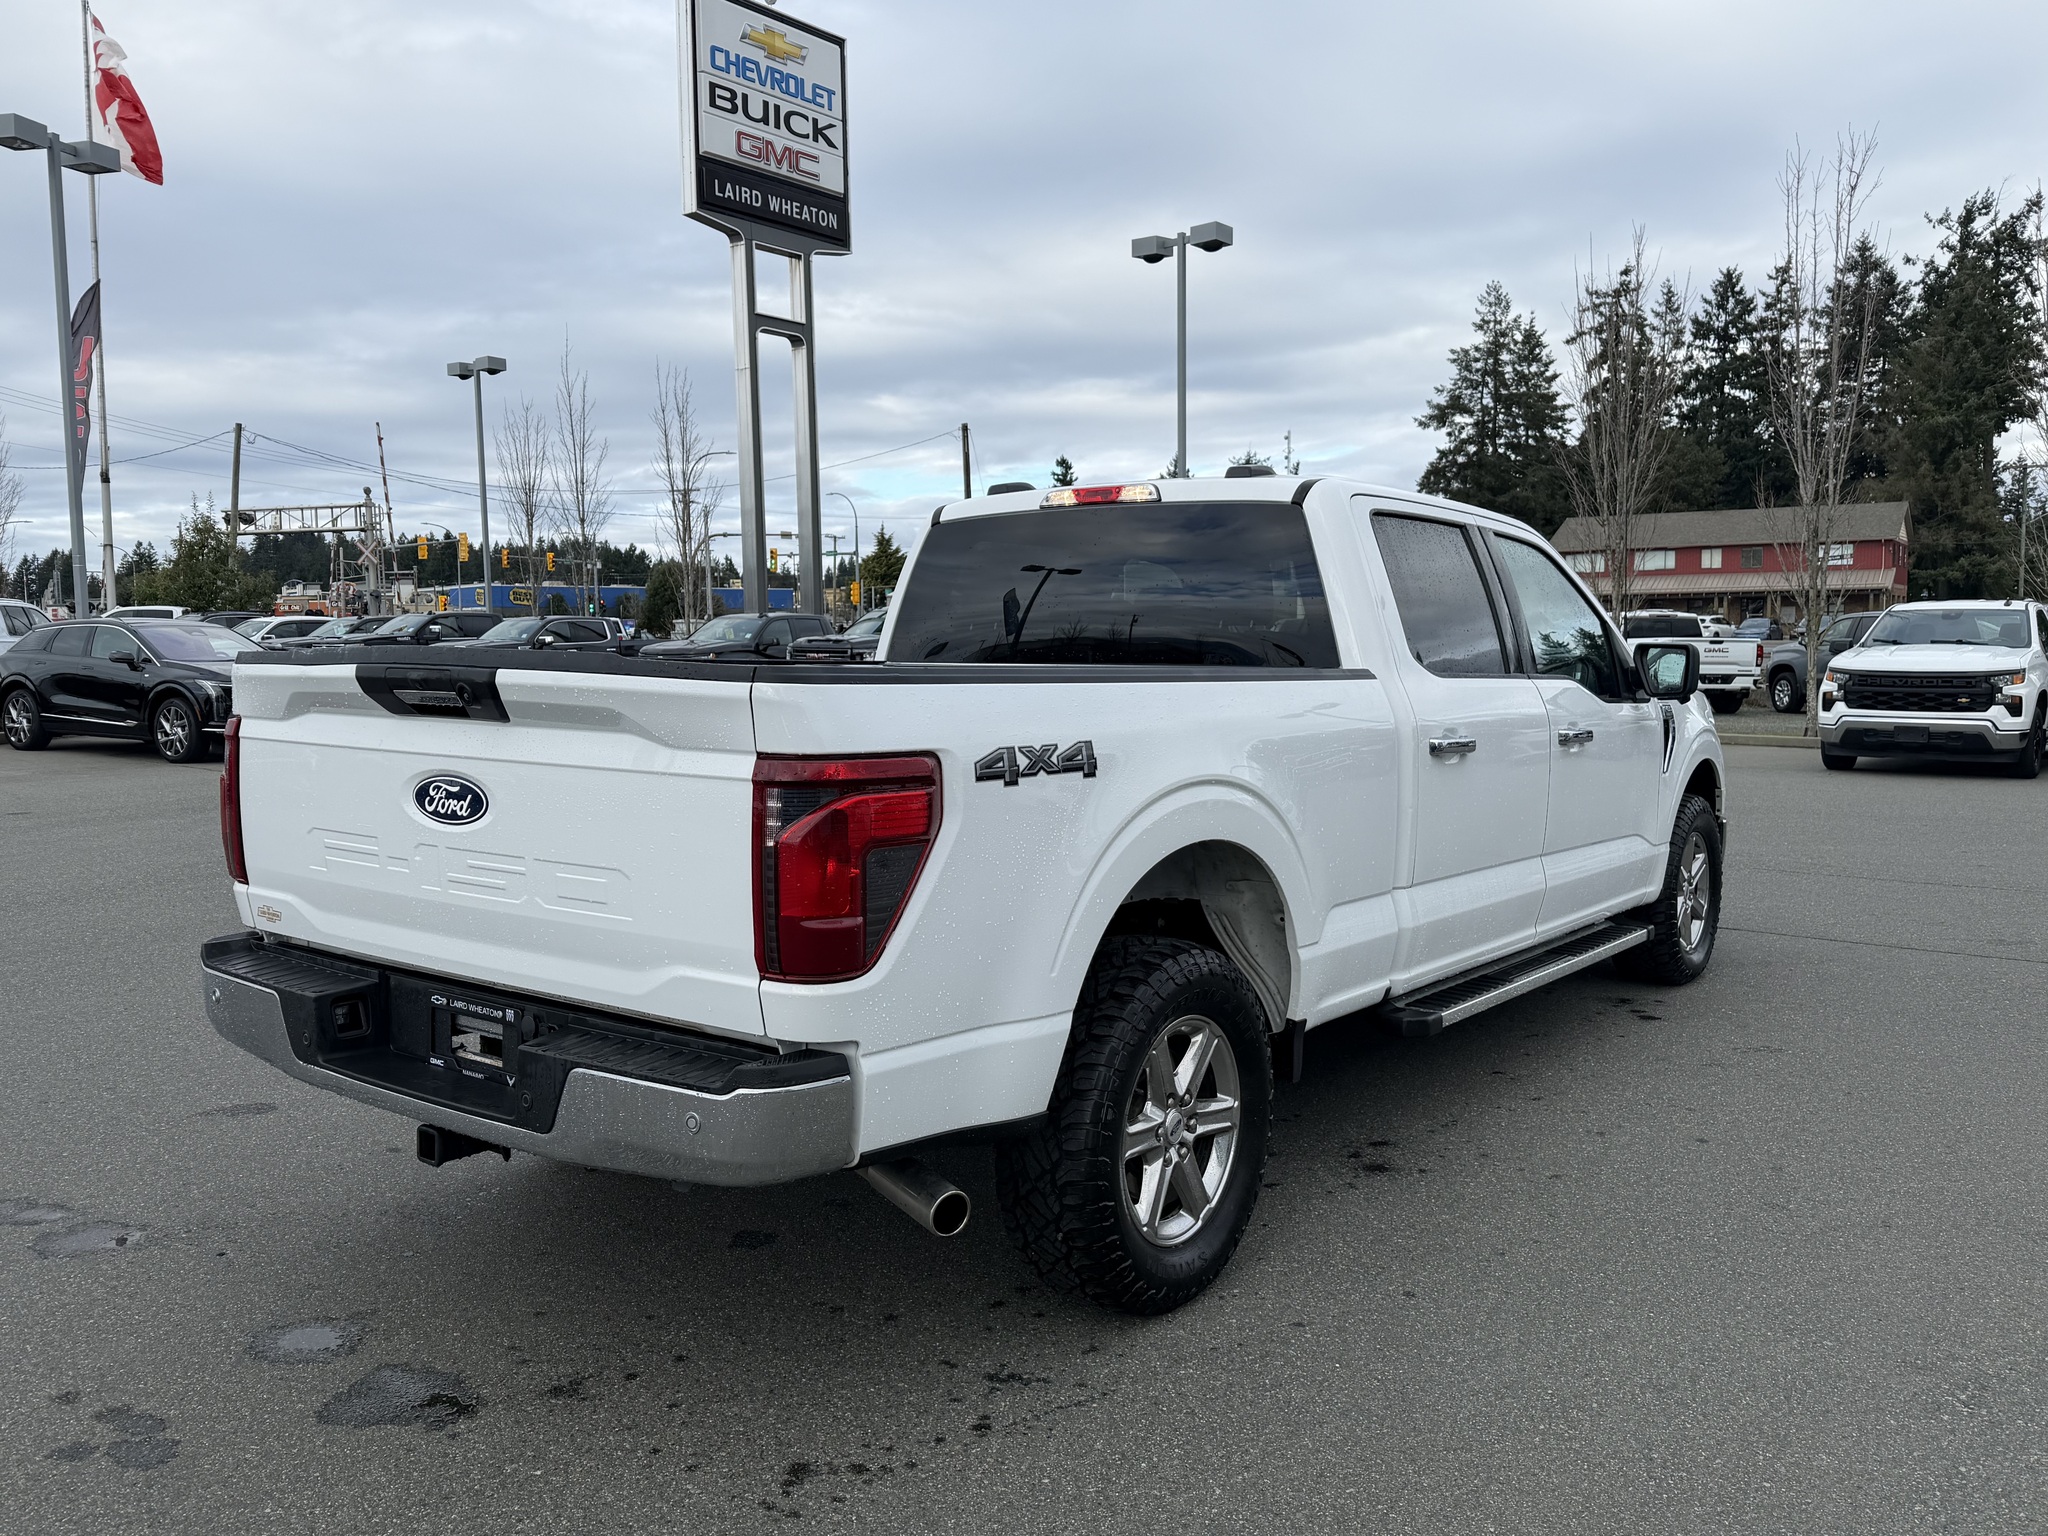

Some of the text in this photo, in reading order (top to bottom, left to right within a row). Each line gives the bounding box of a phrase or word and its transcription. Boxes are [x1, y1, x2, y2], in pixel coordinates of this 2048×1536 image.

[709, 44, 836, 111] CHEVROLET
[708, 80, 839, 150] BUICK
[735, 128, 820, 181] GMC
[714, 179, 838, 230] LAIRD WHEATON
[1855, 676, 1981, 687] CHEVROLET
[424, 782, 472, 817] Ford
[306, 827, 633, 921] F-150
[449, 998, 499, 1018] LAIRD WHEATON
[429, 1057, 445, 1067] GMC
